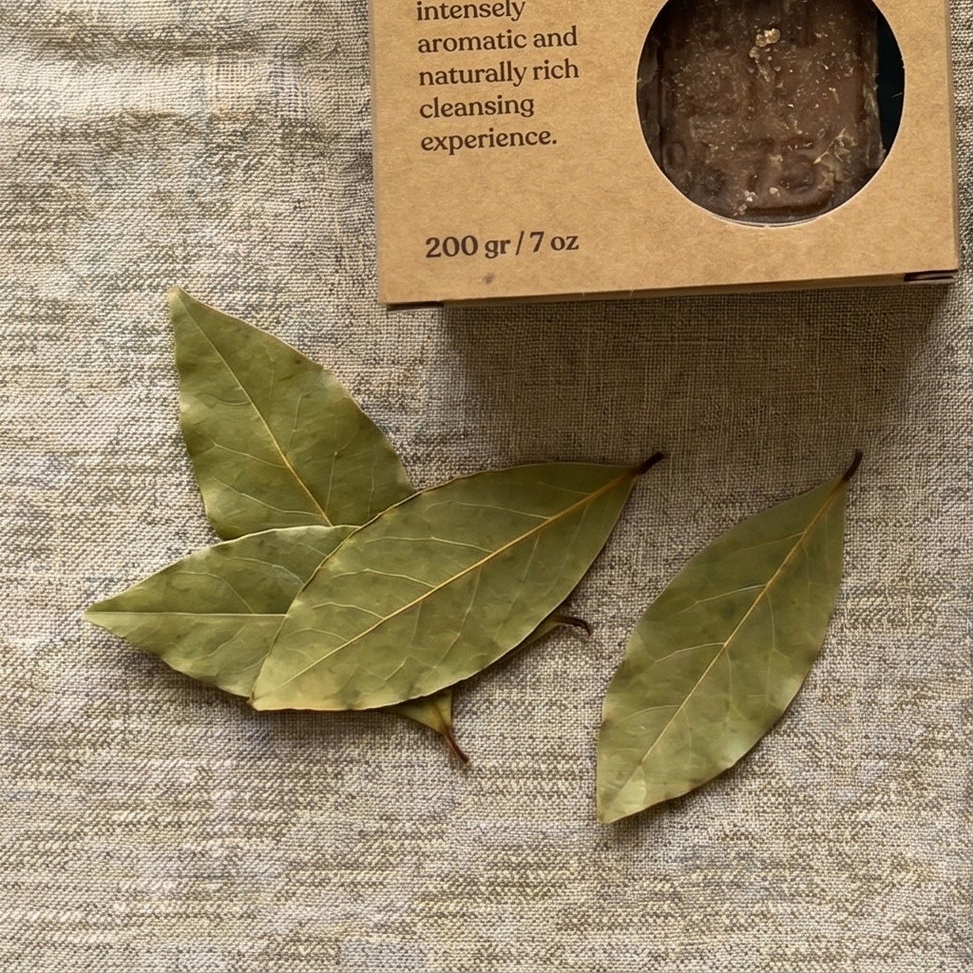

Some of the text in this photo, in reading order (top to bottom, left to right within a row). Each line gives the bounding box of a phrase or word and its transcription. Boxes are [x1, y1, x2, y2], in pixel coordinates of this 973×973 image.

[417, 25, 578, 54] aromatic and
[418, 57, 580, 88] naturally rich
[419, 94, 535, 119] cleansing
[420, 127, 557, 155] experience.
[425, 230, 579, 260] 200 gr / 7 oz
